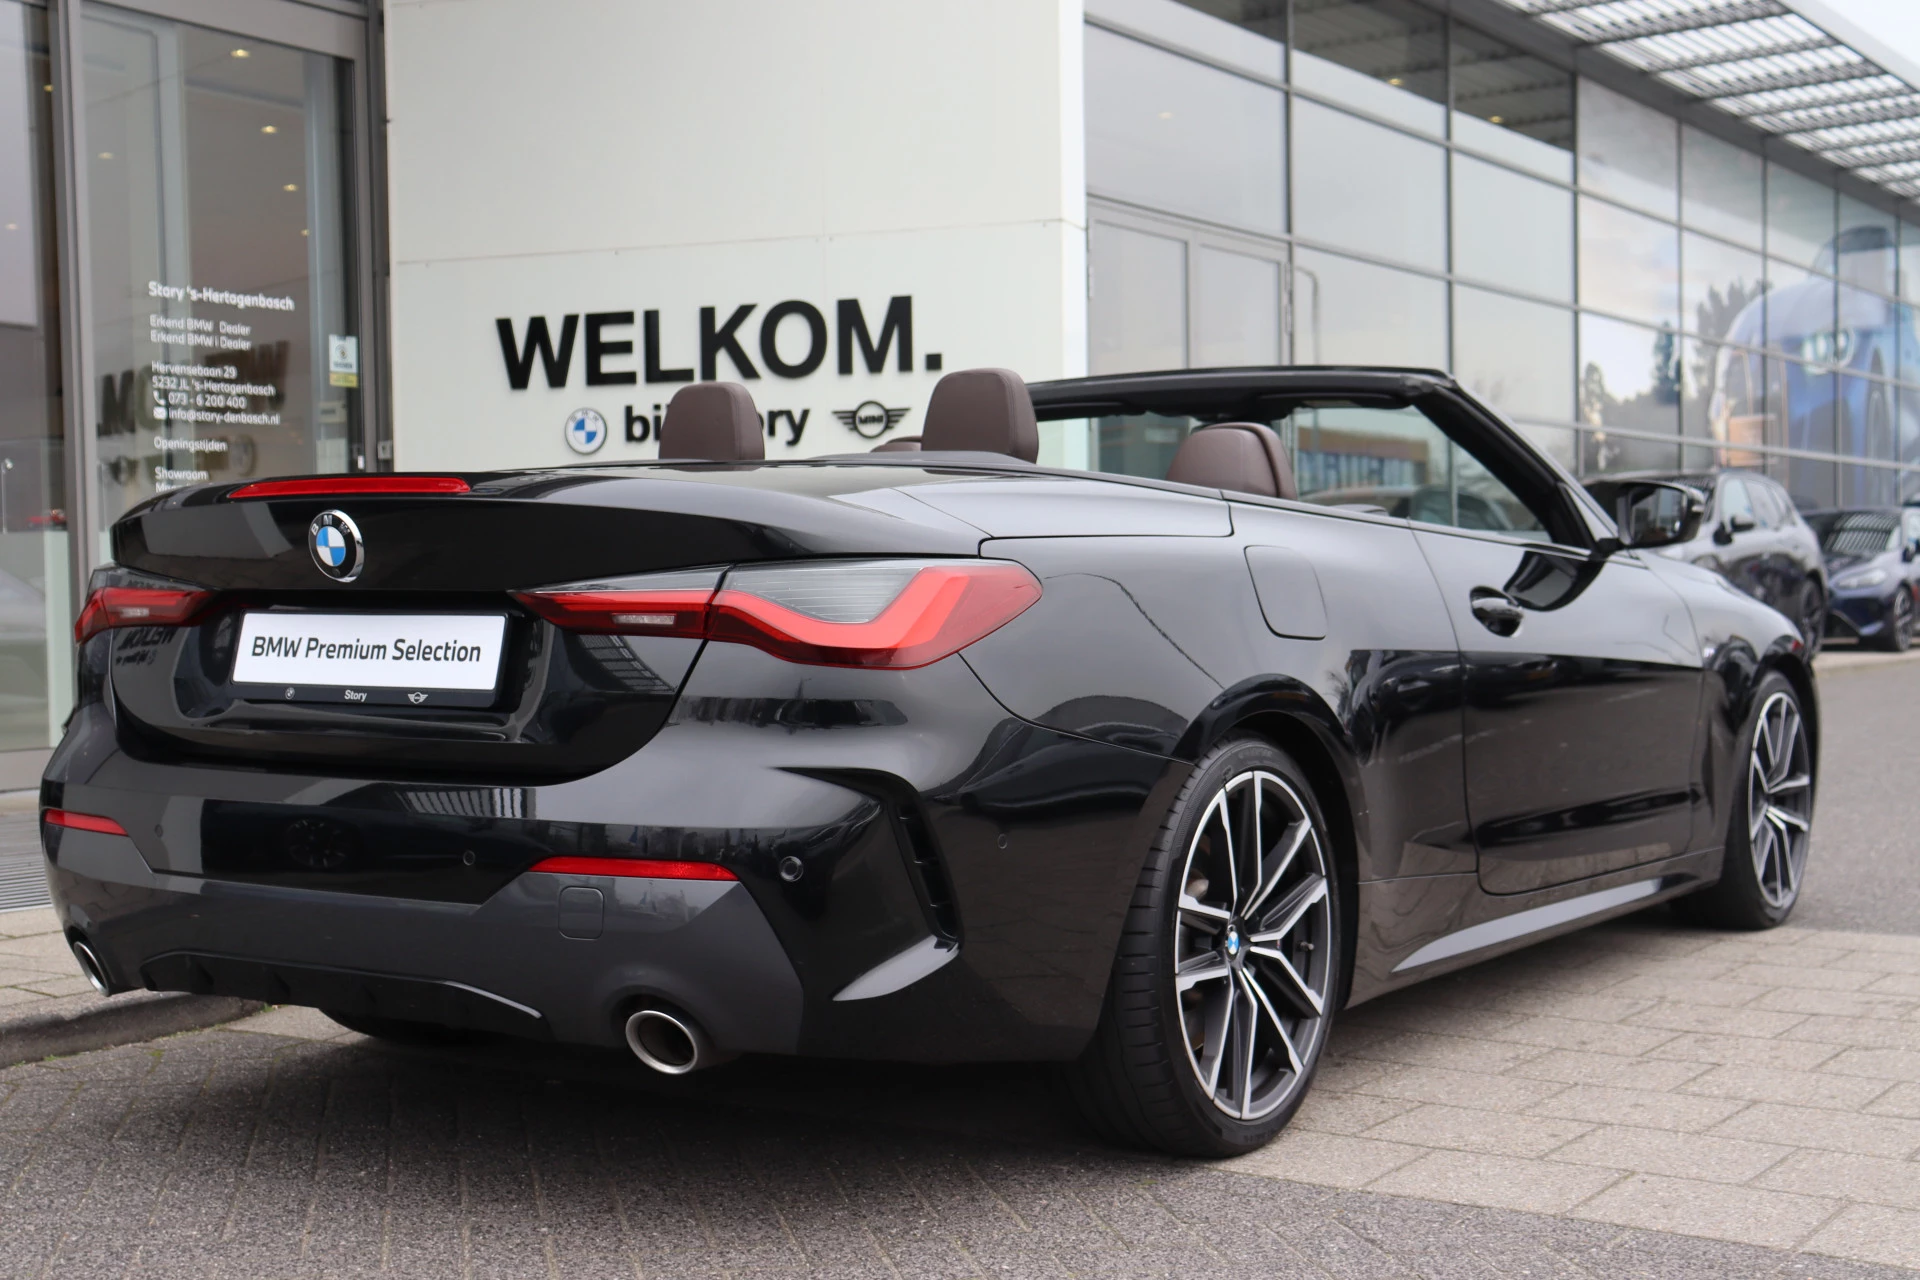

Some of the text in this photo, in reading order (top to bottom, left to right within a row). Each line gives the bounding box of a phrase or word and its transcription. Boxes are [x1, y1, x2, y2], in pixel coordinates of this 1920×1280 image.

[148, 281, 295, 311] Story 's-Hertogenbosch
[149, 314, 252, 336] Erkend BMW Dealer
[150, 330, 185, 345] Erkend
[187, 333, 213, 347] BMW
[219, 336, 252, 351] Dealer
[495, 295, 943, 391] WELKOM.
[151, 360, 238, 379] Hervensebaan 29
[152, 375, 276, 396] 5232 JL 's-Hertogenbosch
[168, 391, 188, 405] 073
[196, 394, 203, 407] 6
[204, 394, 225, 408] 200
[226, 396, 247, 409] 400
[168, 407, 281, 425] info@story-denbosch.nl
[625, 404, 668, 442] bi
[153, 436, 228, 453] Openingstijden
[154, 466, 209, 480] Showroom
[251, 636, 481, 663] BMW Premium Selection
[344, 689, 368, 702] Story
